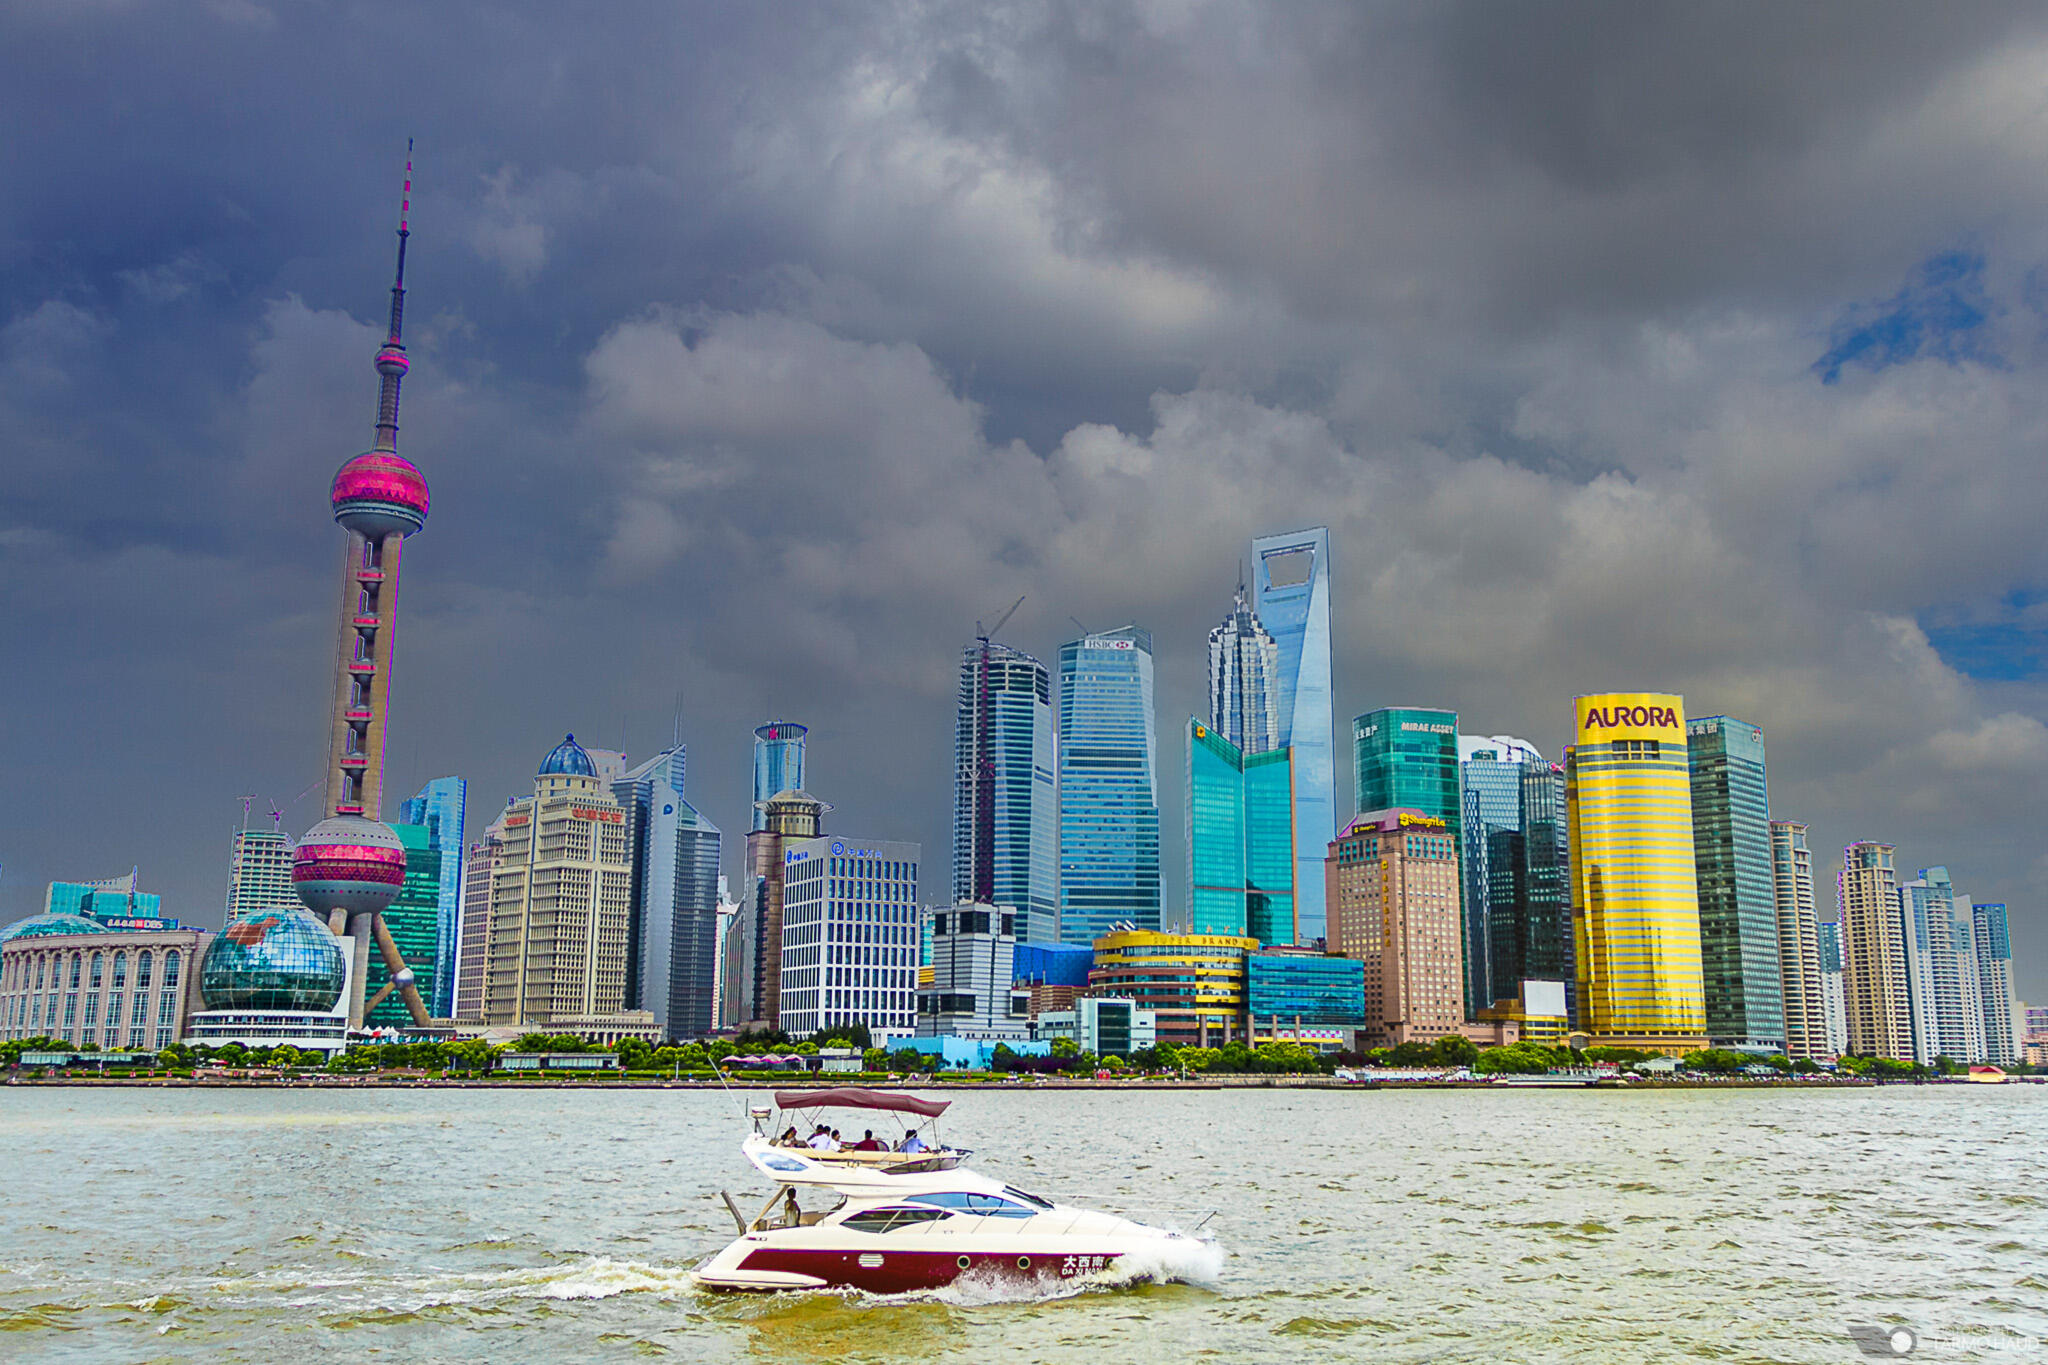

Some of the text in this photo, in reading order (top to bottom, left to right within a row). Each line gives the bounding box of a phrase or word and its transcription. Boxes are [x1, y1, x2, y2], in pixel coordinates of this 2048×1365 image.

[1089, 640, 1114, 649] HSBC
[1584, 705, 1679, 730] AURORA
[1401, 722, 1454, 735] MIRAE ASSET
[1202, 937, 1238, 946] BRAND
[1063, 1255, 1105, 1268] 大西南
[1061, 1268, 1074, 1276] DA
